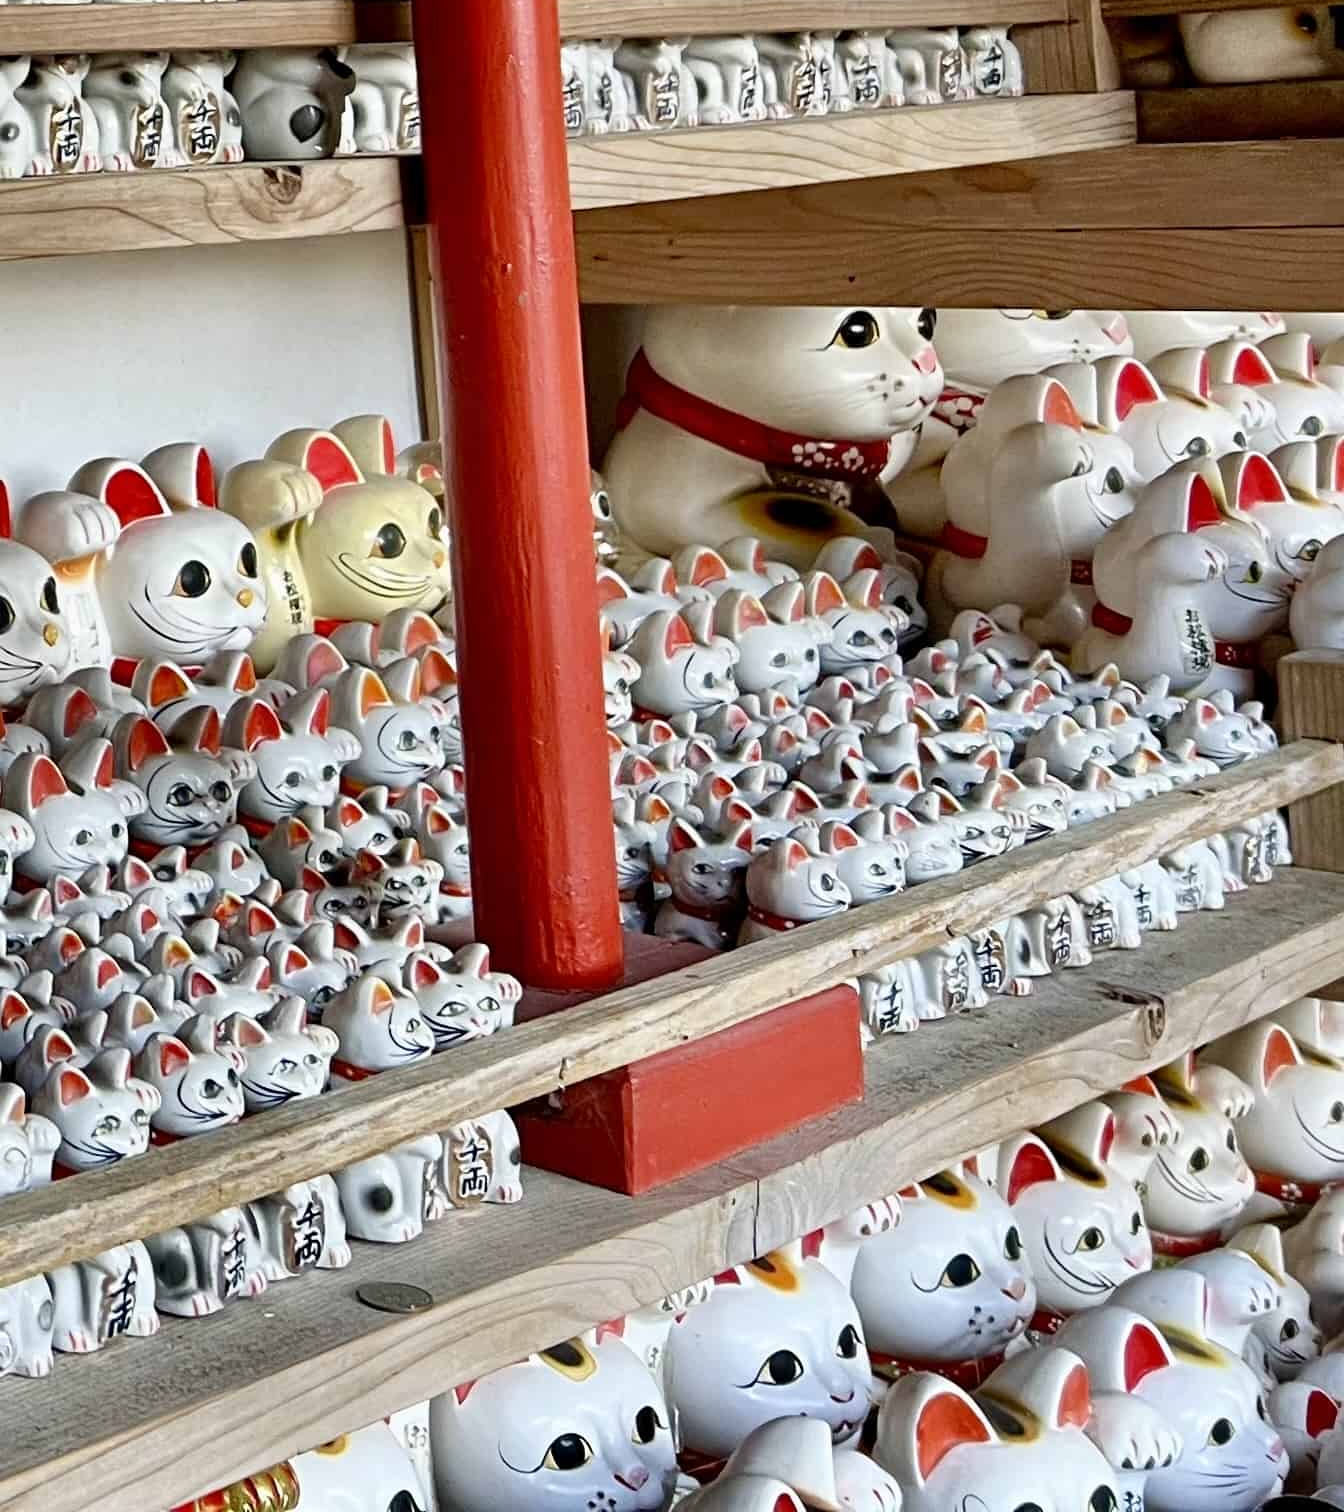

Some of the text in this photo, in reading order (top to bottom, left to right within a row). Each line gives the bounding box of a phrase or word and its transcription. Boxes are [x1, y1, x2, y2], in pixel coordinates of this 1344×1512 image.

[56, 103, 81, 164] 千両
[187, 99, 218, 154] 千両
[974, 935, 1003, 989] 千両
[459, 1138, 488, 1196] 千両
[295, 1201, 322, 1267] 千両
